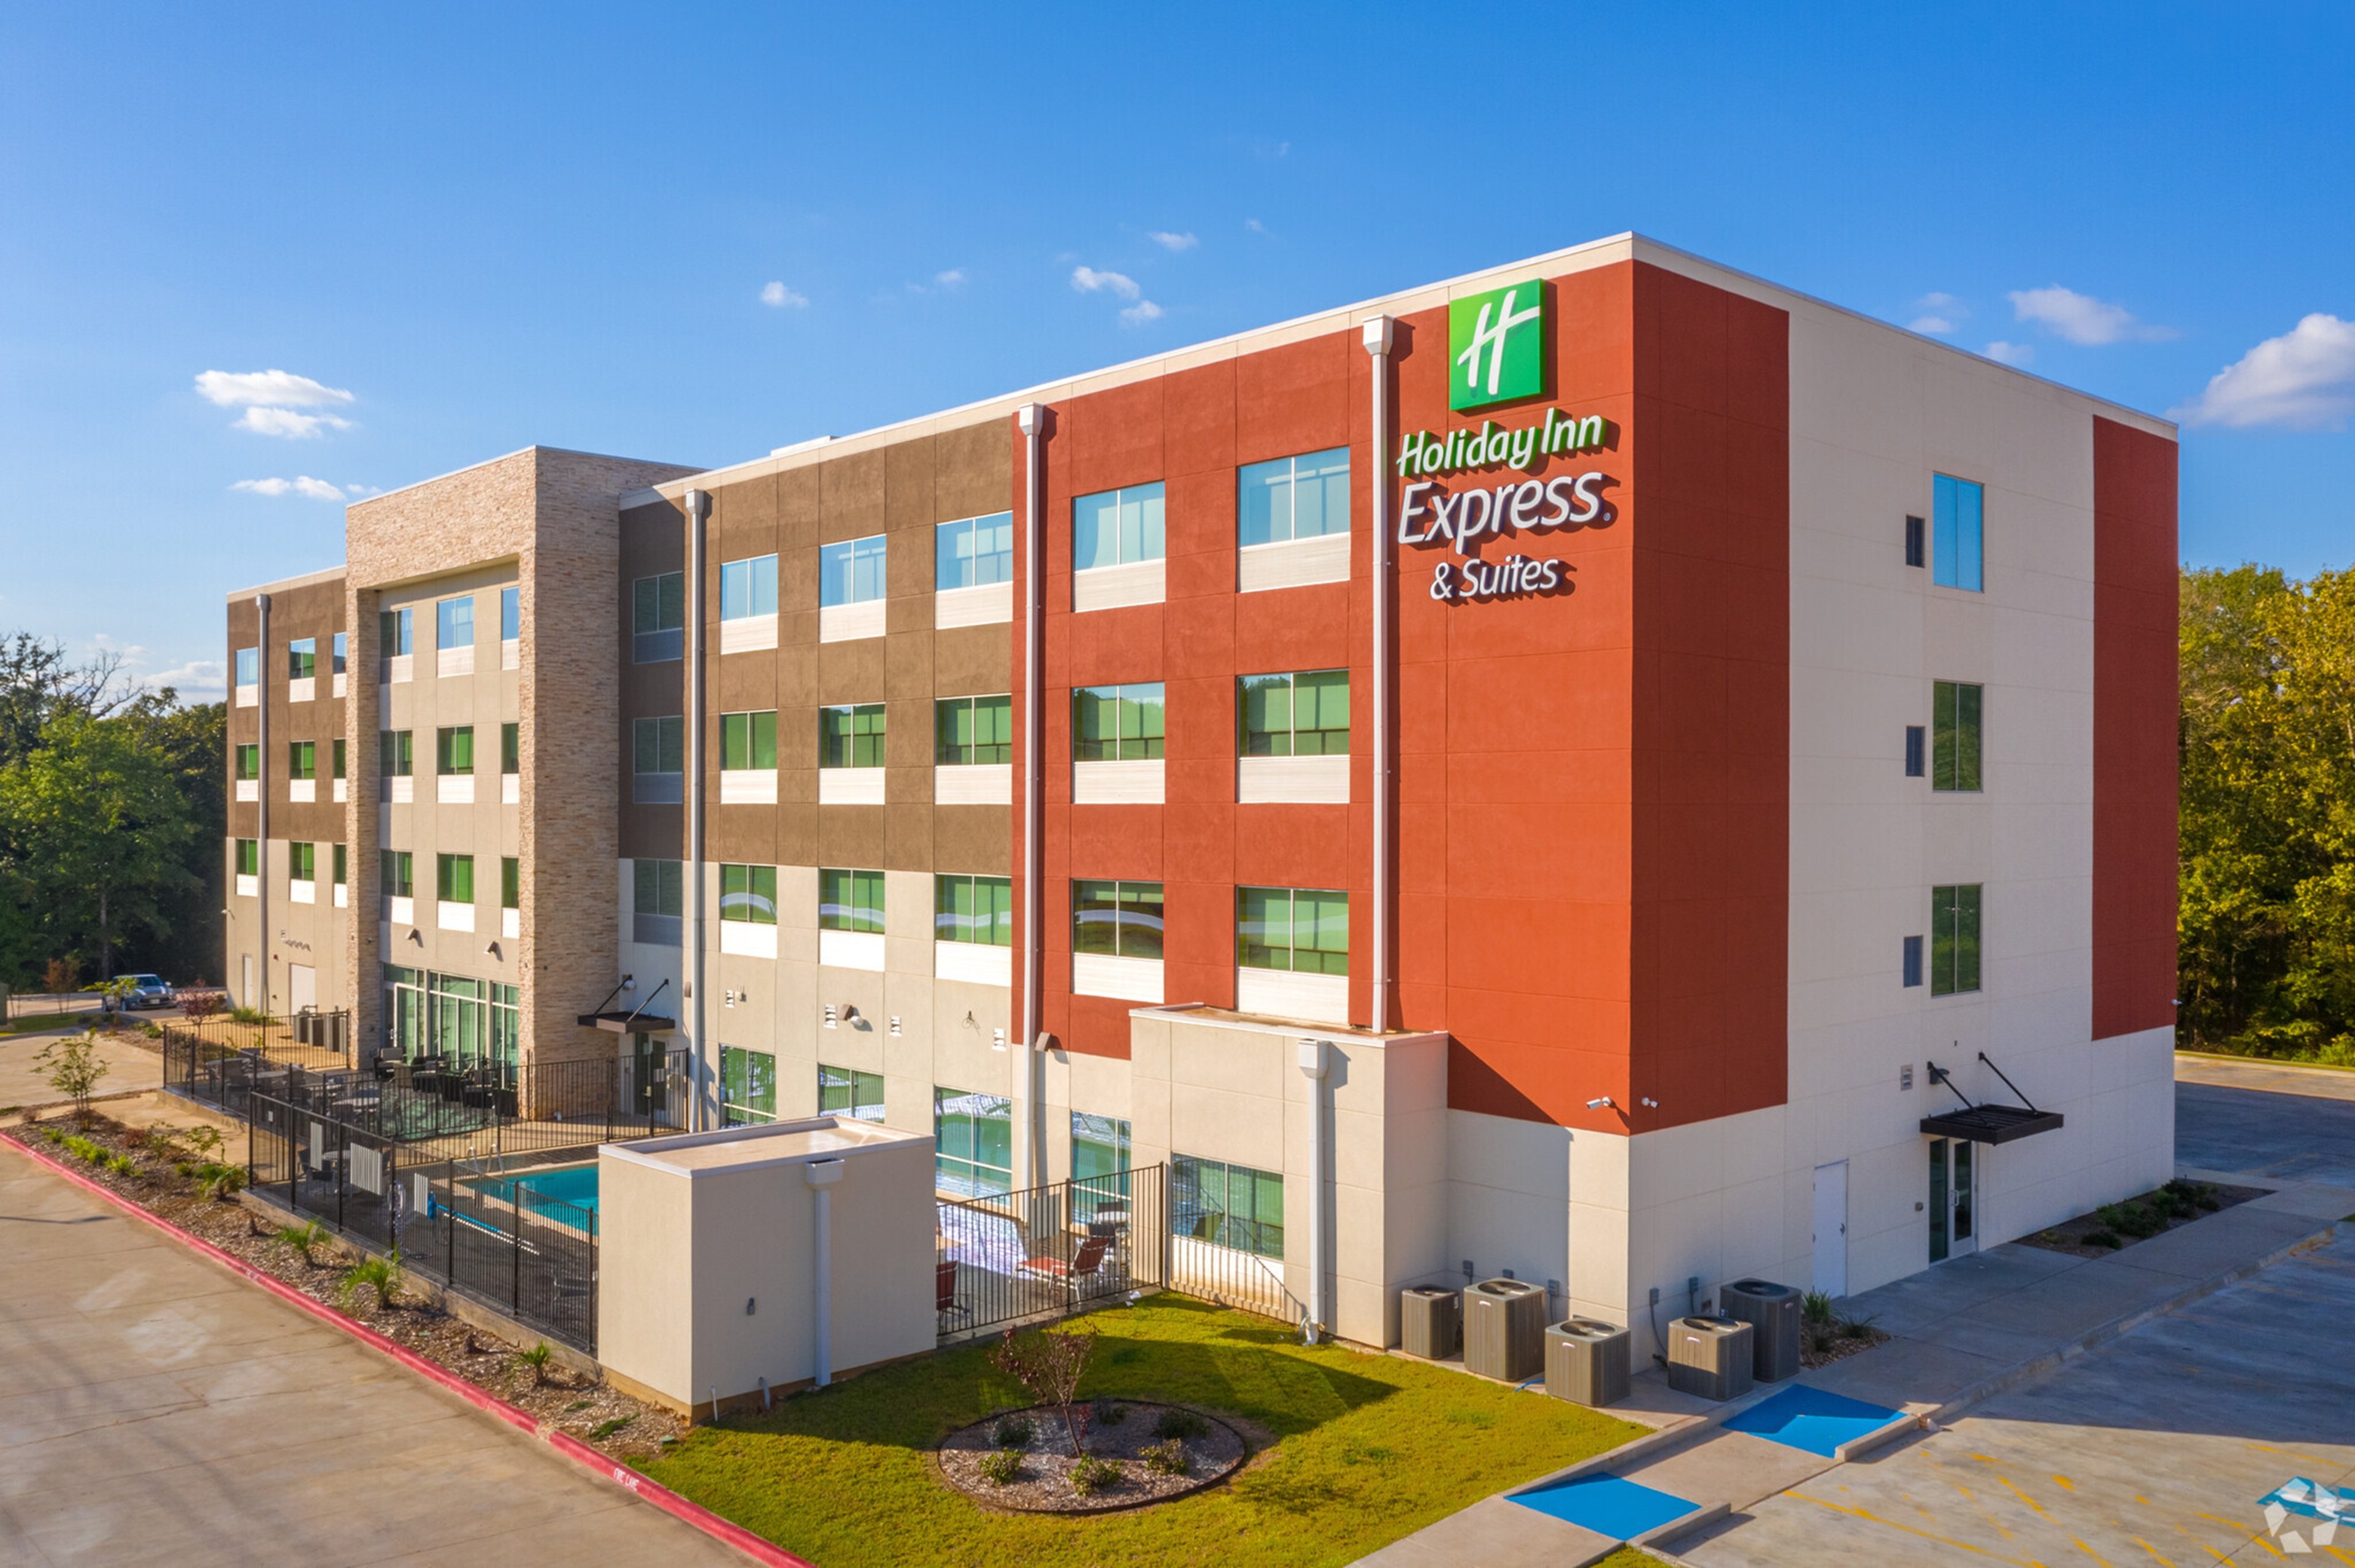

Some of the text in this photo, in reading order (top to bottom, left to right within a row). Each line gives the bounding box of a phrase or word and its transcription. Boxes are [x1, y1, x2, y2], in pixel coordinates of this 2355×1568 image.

[1457, 290, 1540, 395] H
[1396, 407, 1603, 477] Holiday Inn
[1398, 472, 1604, 554] Express
[1430, 554, 1559, 600] & Suites
